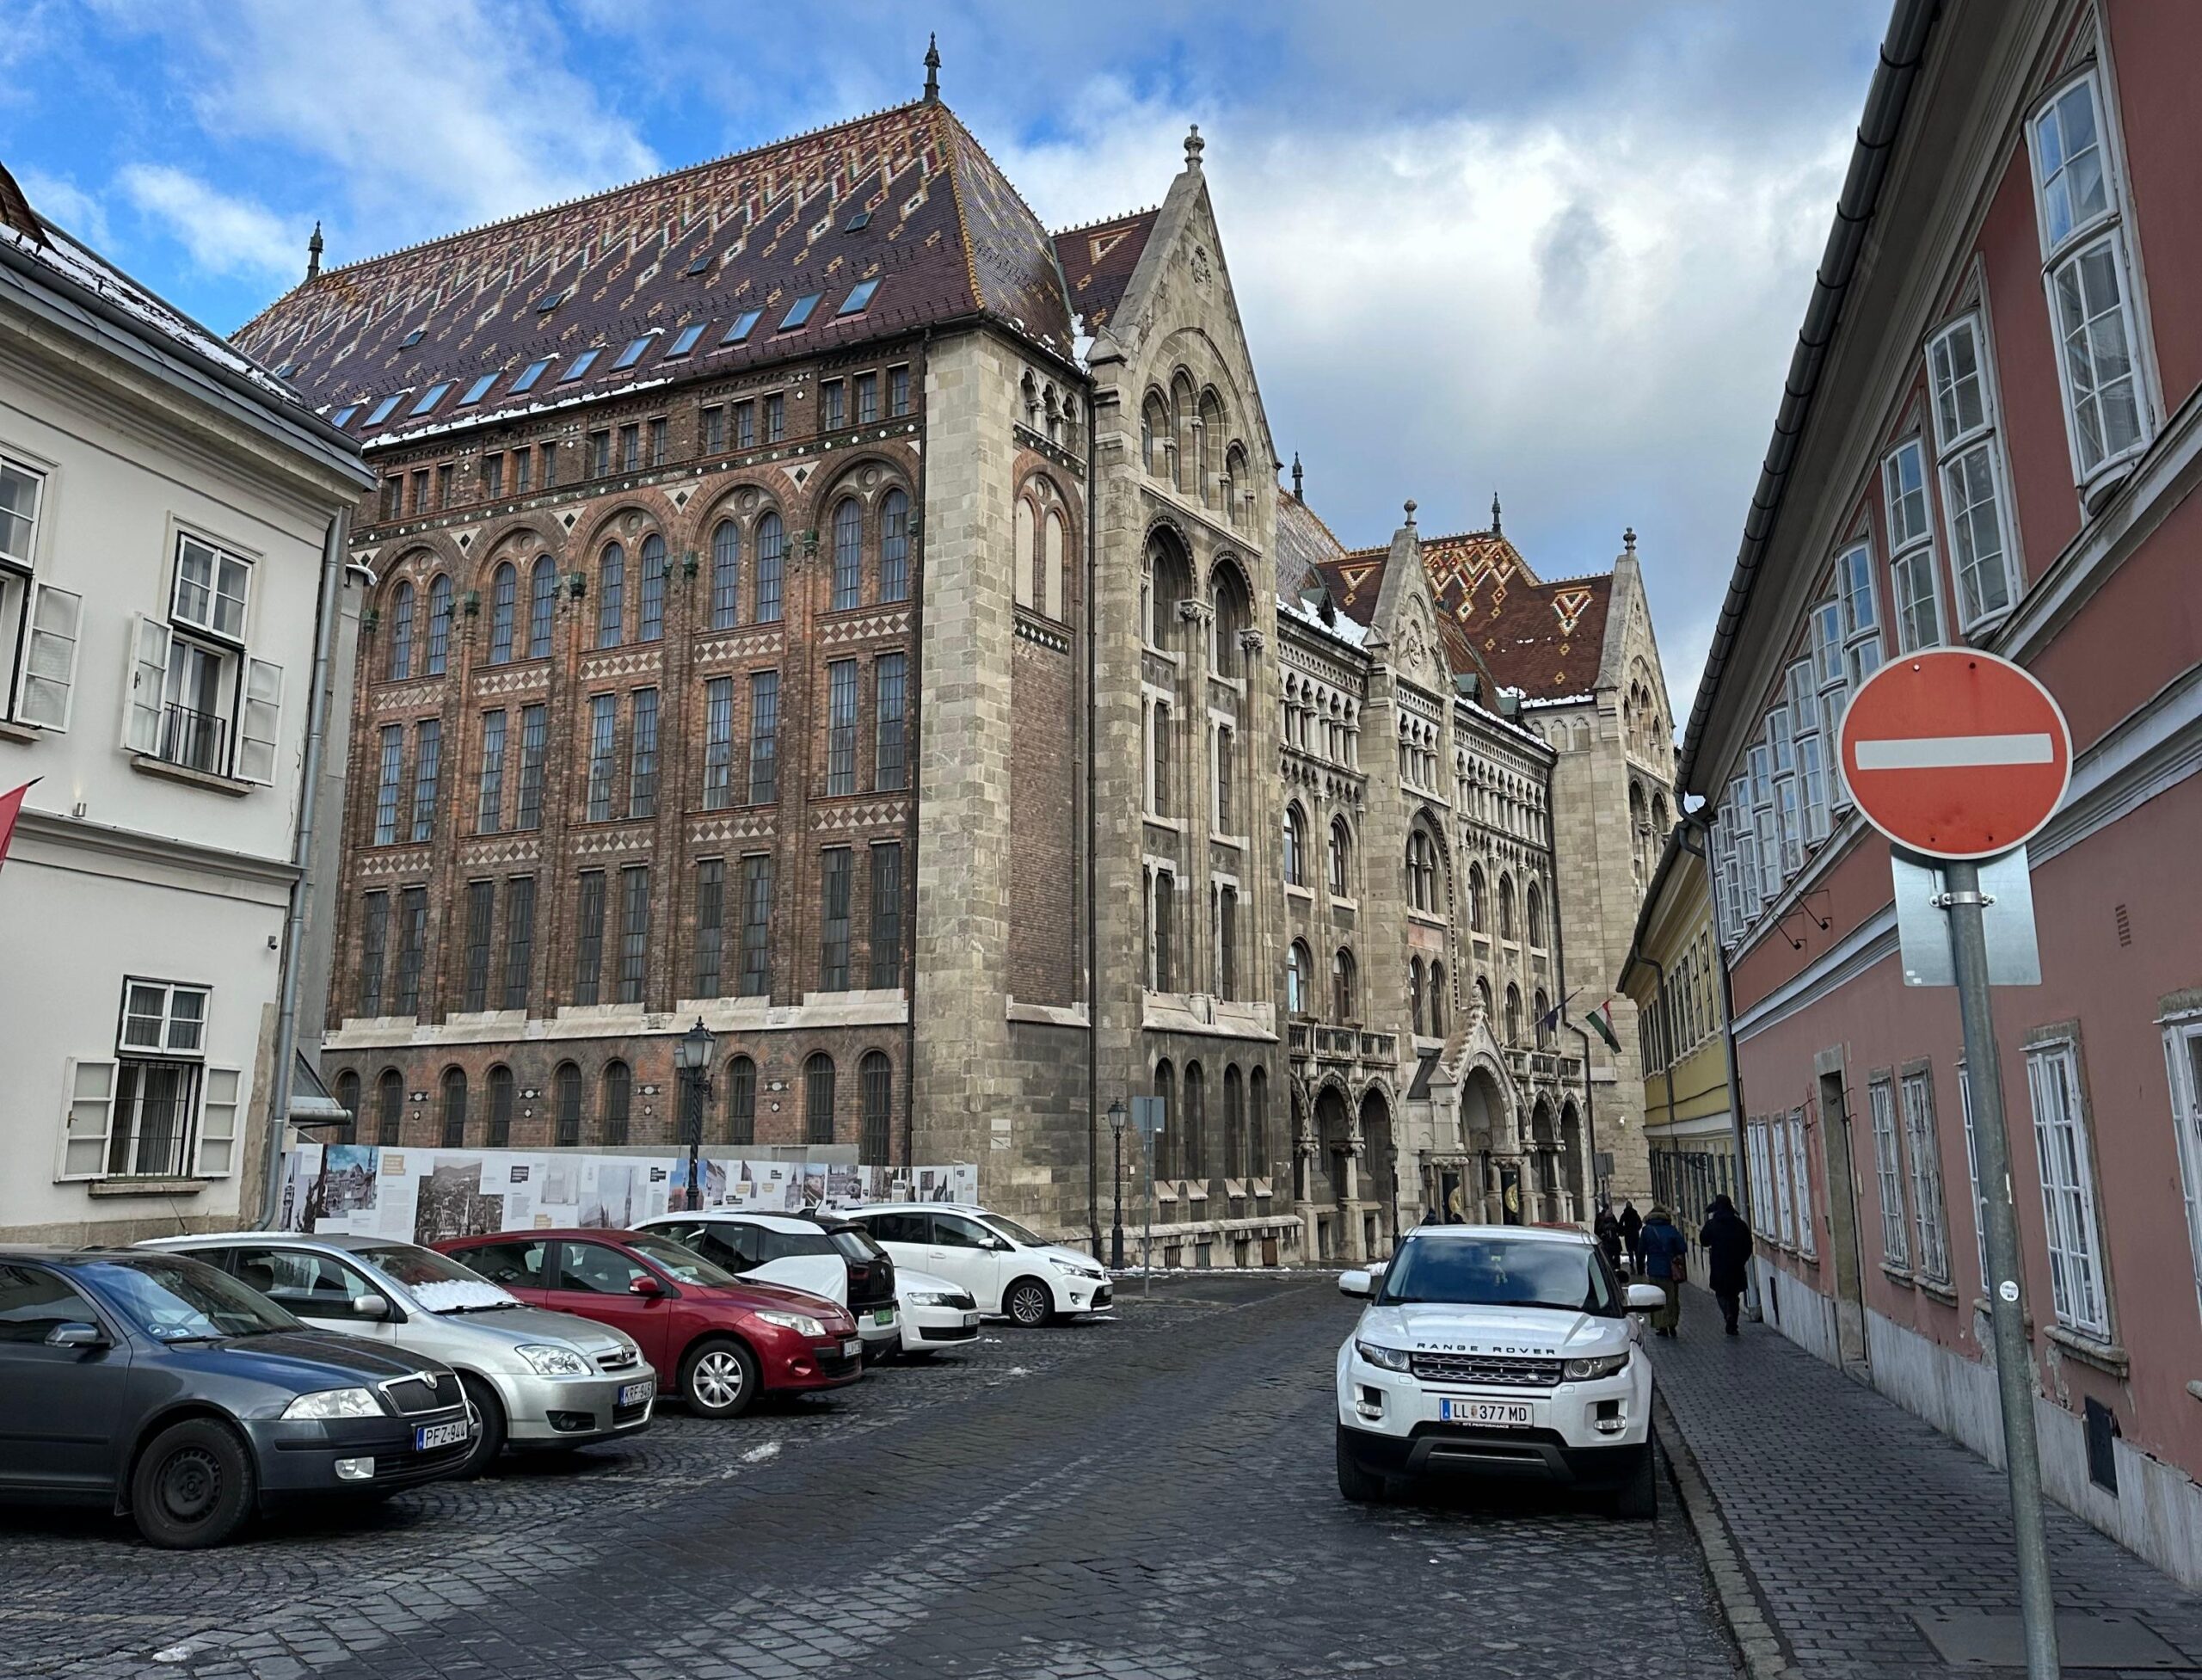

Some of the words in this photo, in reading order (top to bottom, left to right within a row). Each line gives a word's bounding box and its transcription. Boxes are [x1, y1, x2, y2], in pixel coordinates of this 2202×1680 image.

[1417, 1343, 1479, 1351] RANGE
[1492, 1346, 1555, 1355] ROVER
[1454, 1403, 1469, 1418] LL
[1479, 1405, 1504, 1420] 377
[1509, 1406, 1527, 1422] MD
[426, 1422, 465, 1448] PFZ-944
